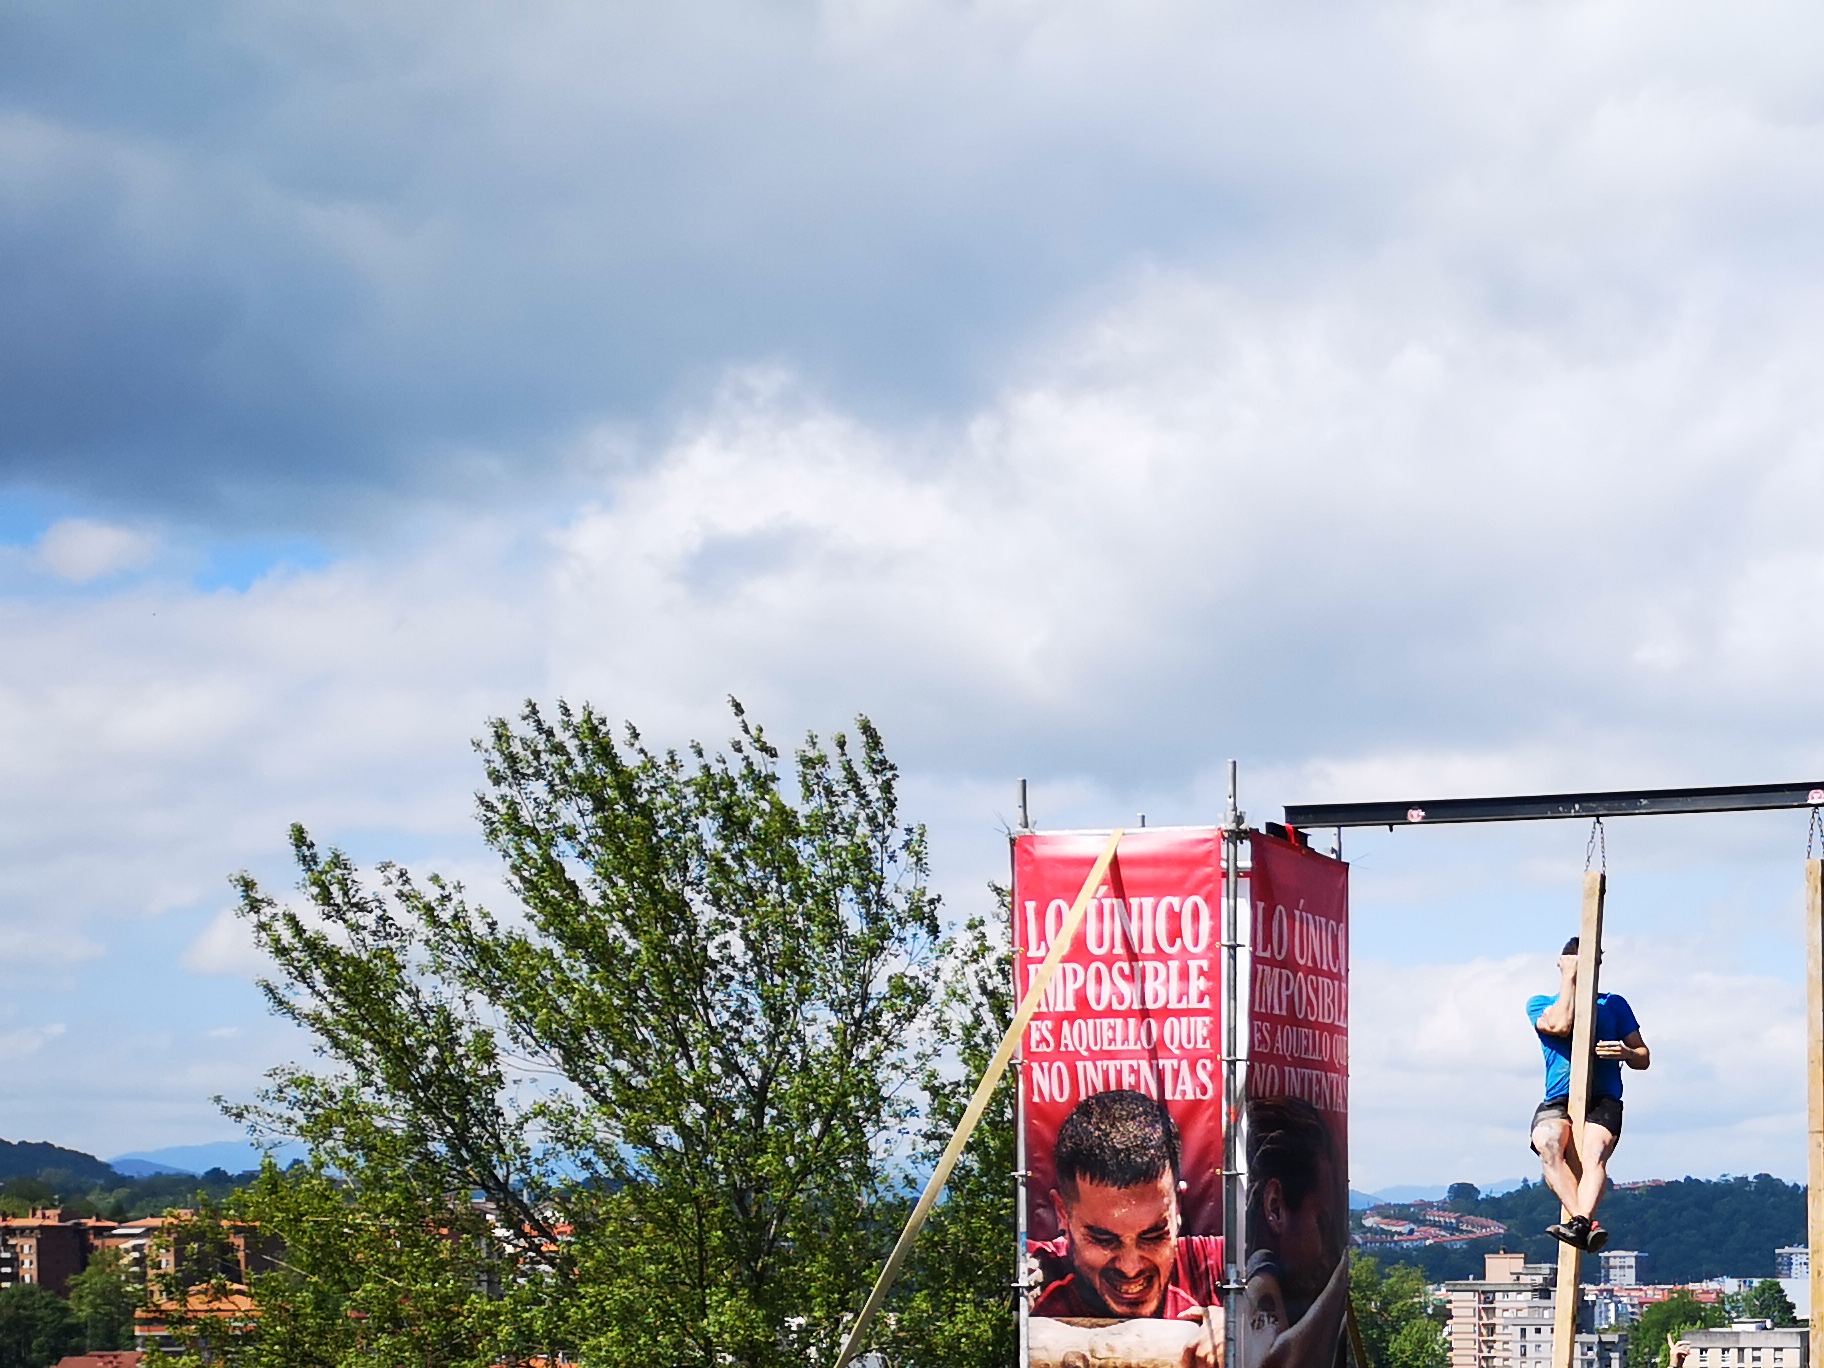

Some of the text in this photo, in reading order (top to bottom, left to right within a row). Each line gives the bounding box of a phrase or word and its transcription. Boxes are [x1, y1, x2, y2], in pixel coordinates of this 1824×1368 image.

[1024, 886, 1210, 957] LO ÚNICO
[1256, 899, 1345, 976] LO ÚNICO
[1254, 964, 1347, 1028] IMPOSIBLE
[1029, 1016, 1211, 1056] ES AQUELLO QUE
[1254, 1021, 1347, 1068] ES AQUELLO QUE
[1030, 1059, 1214, 1103] NO INTENTAS
[1251, 1062, 1279, 1098] NO
